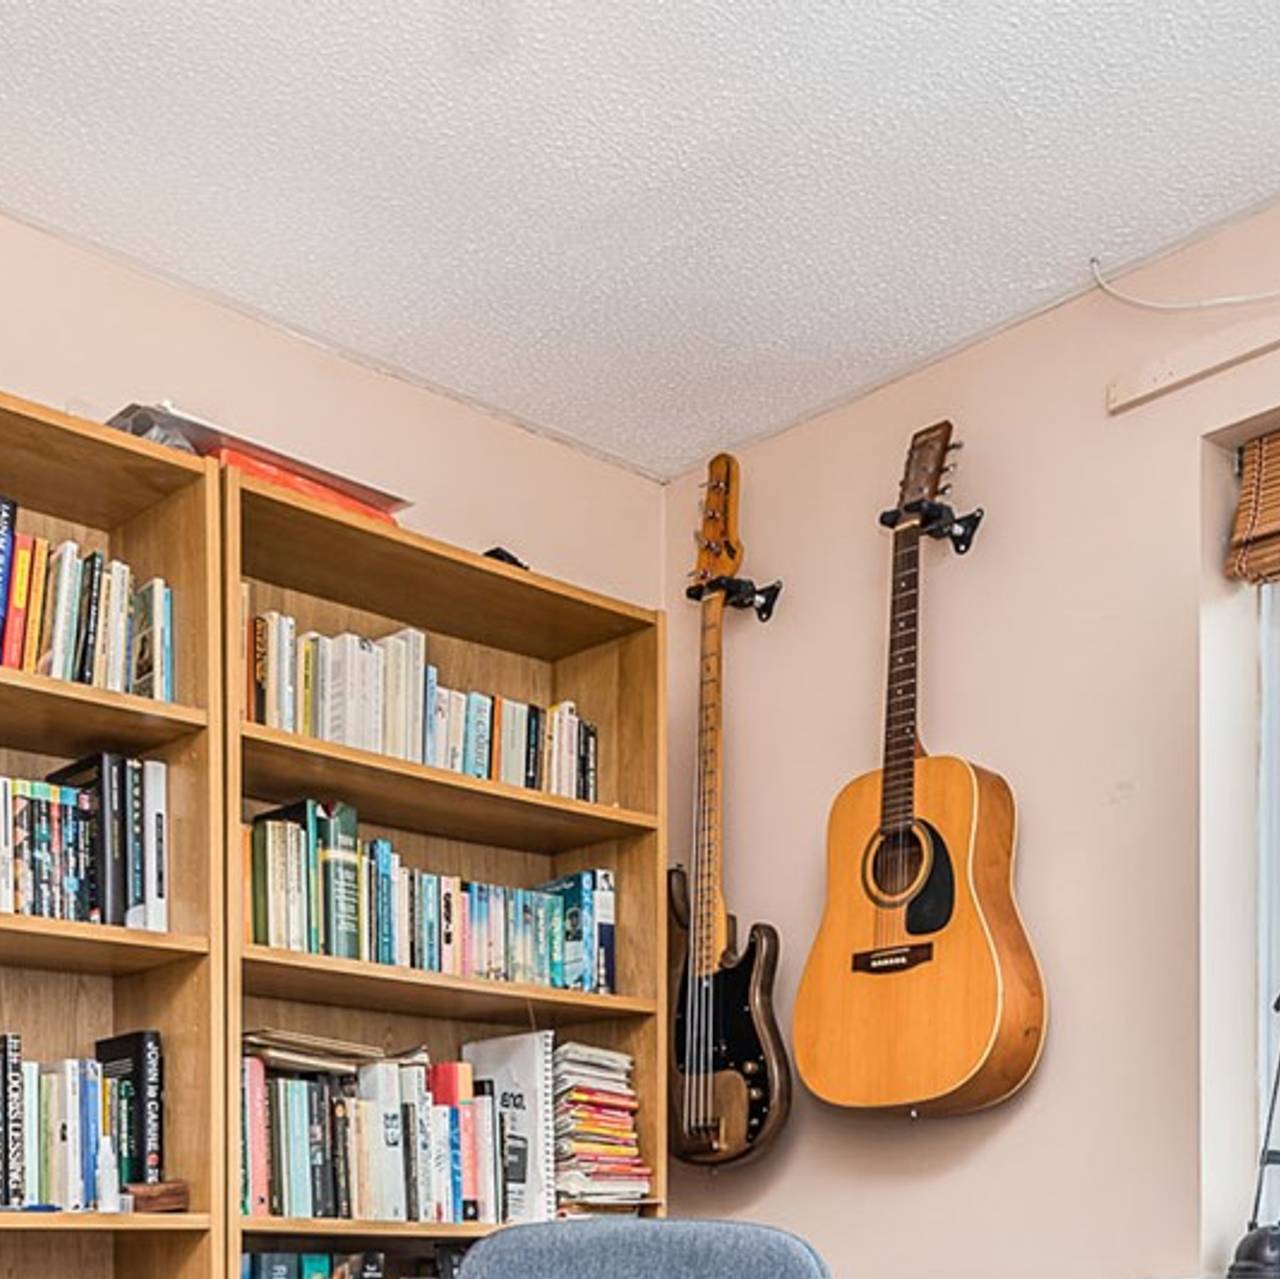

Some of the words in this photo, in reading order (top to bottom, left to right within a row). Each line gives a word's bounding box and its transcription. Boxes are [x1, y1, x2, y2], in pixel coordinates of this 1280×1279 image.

[147, 1041, 160, 1082] JOHN
[8, 1071, 23, 1120] DORIS
[8, 1123, 23, 1189] LESSING
